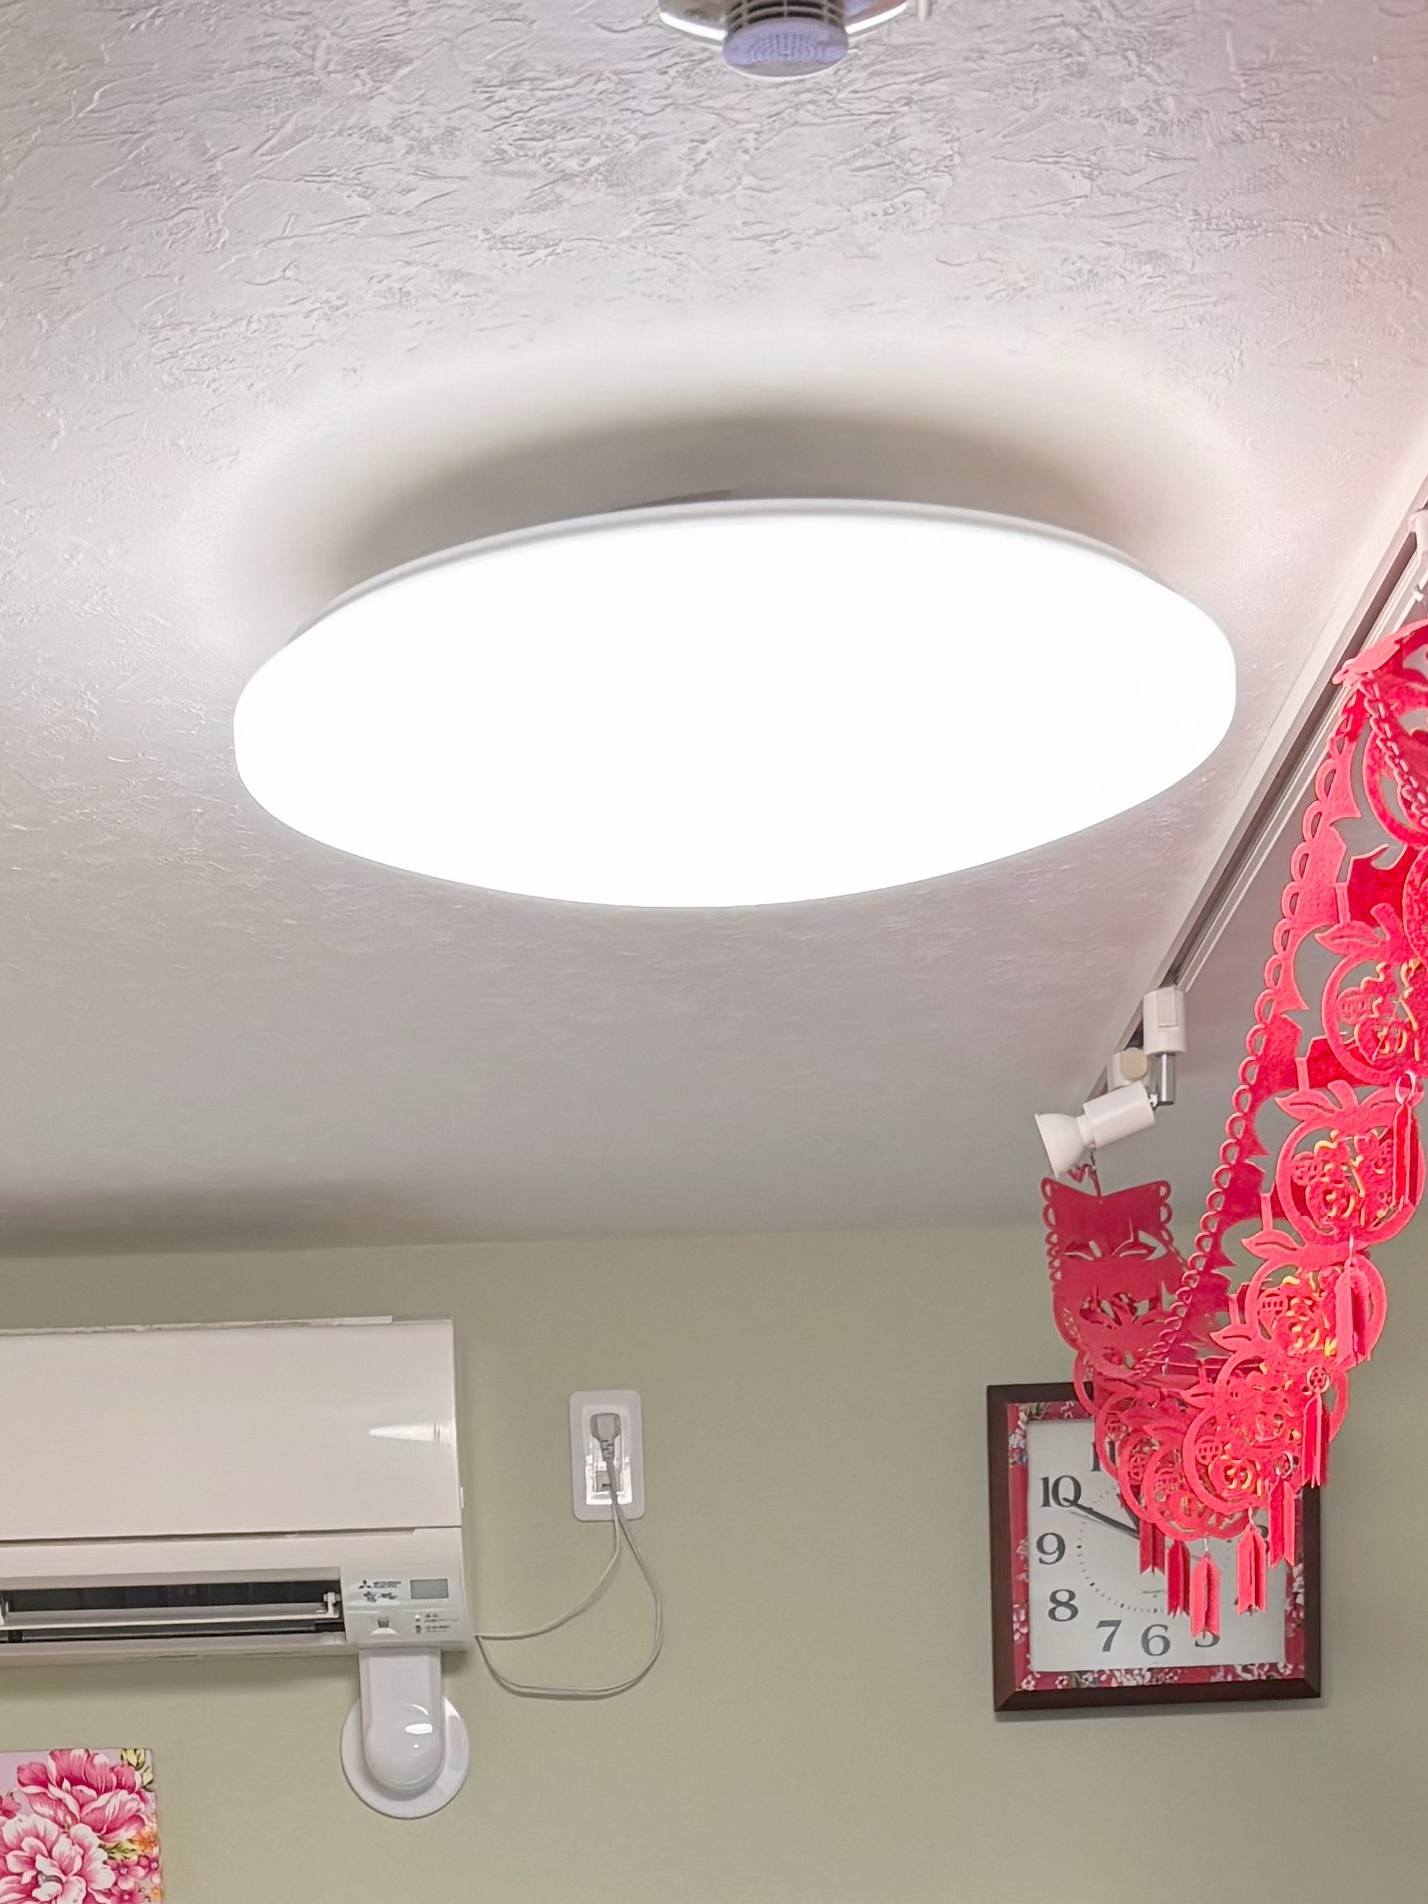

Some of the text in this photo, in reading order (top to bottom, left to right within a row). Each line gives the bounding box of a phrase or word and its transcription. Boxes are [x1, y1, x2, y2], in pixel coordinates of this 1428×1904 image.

[1039, 1474, 1082, 1508] 10
[1035, 1532, 1066, 1565] 9
[1047, 1588, 1080, 1622] 8
[1095, 1619, 1122, 1653] 7
[1140, 1623, 1171, 1657] 6
